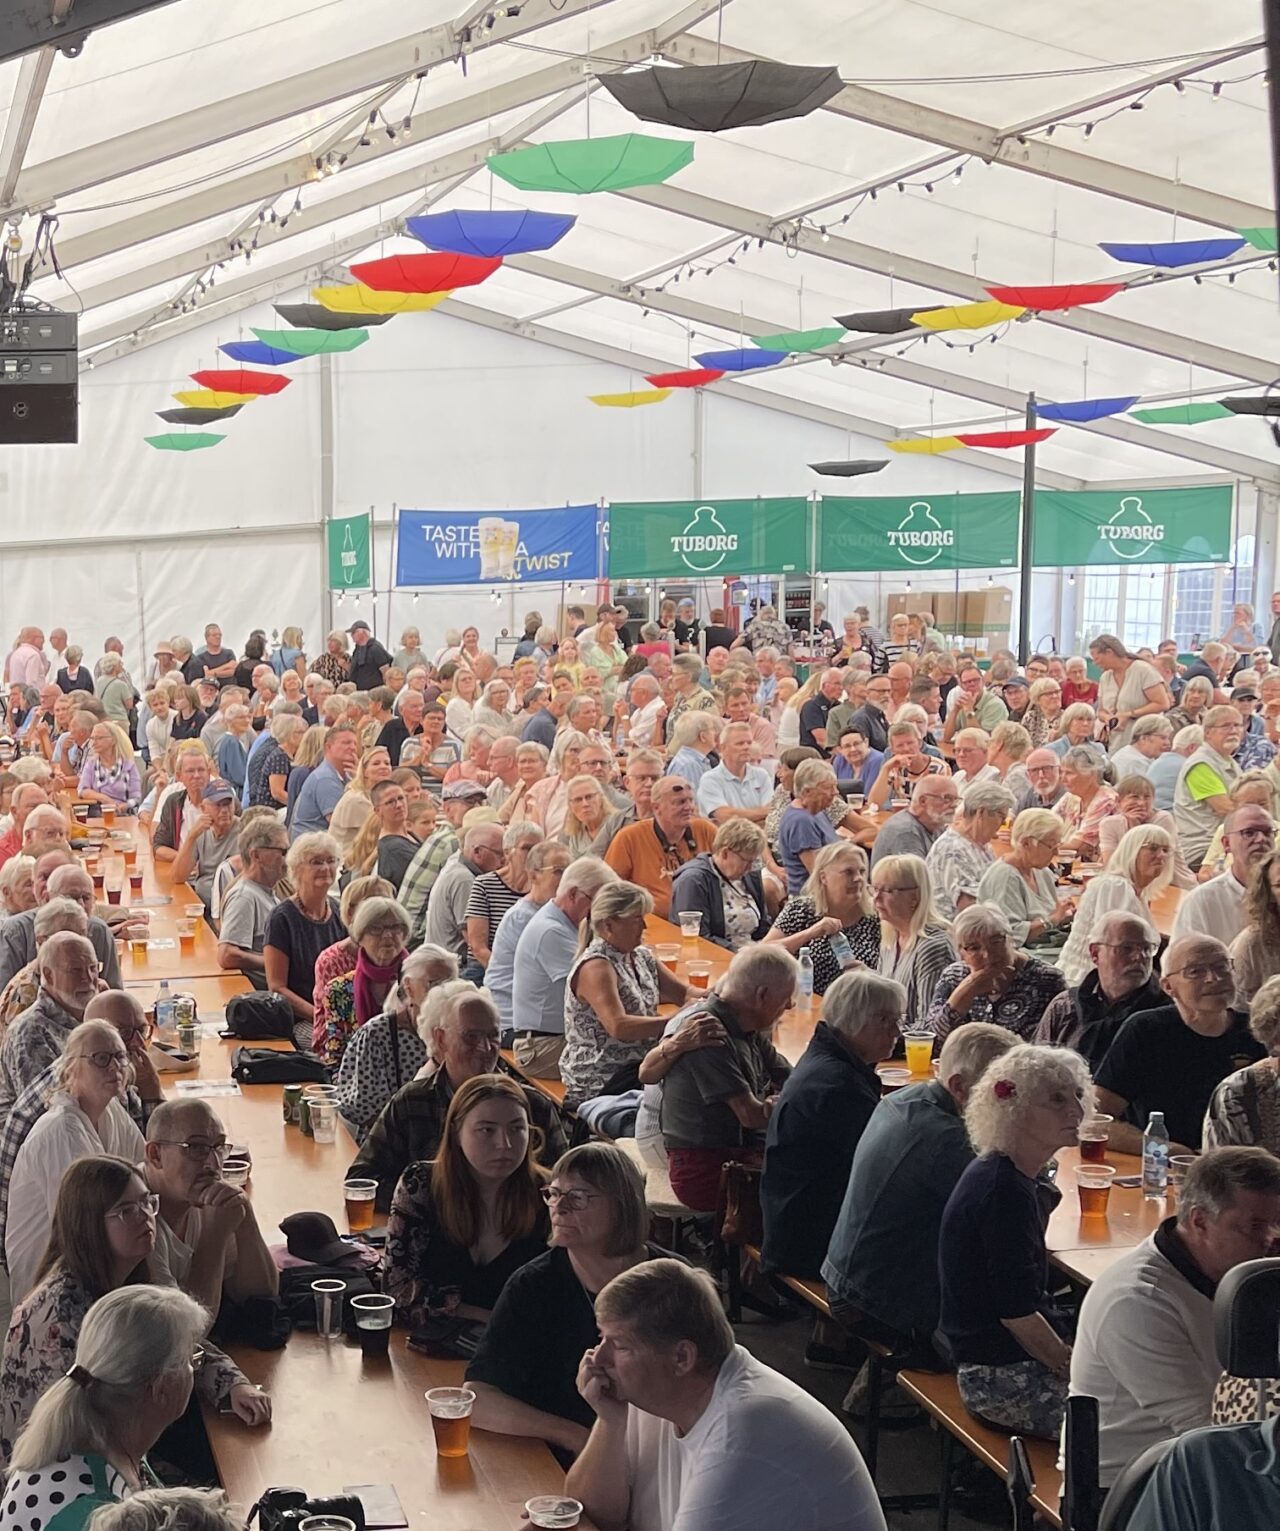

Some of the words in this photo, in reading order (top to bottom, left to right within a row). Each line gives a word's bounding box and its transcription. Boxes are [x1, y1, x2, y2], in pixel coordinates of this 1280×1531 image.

[421, 525, 480, 542] TASTE
[887, 530, 954, 547] TUBORG
[1097, 525, 1164, 540] TUBORG
[515, 541, 529, 556] A
[670, 534, 738, 552] TUBORG
[514, 552, 573, 572] TWIST
